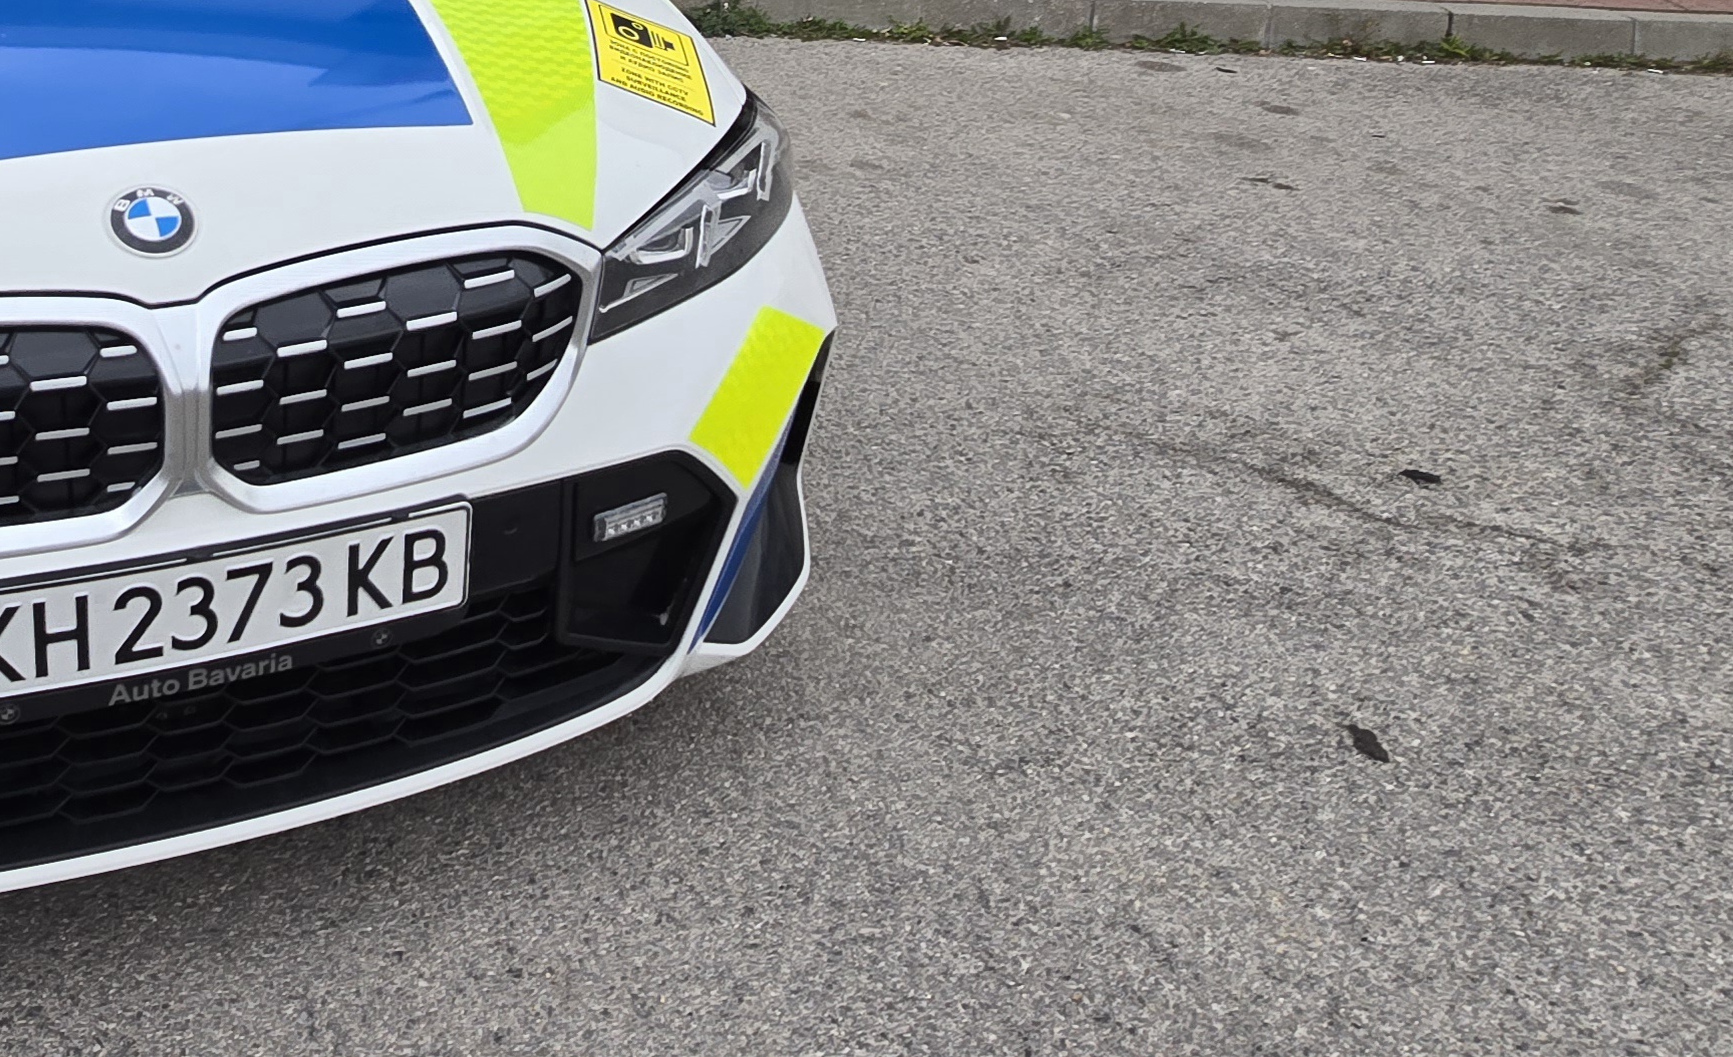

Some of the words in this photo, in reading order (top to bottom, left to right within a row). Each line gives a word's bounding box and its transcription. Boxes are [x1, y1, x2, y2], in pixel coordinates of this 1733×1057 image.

[113, 187, 185, 213] BMW
[108, 677, 181, 708] Auto
[187, 651, 293, 691] Bavaria
